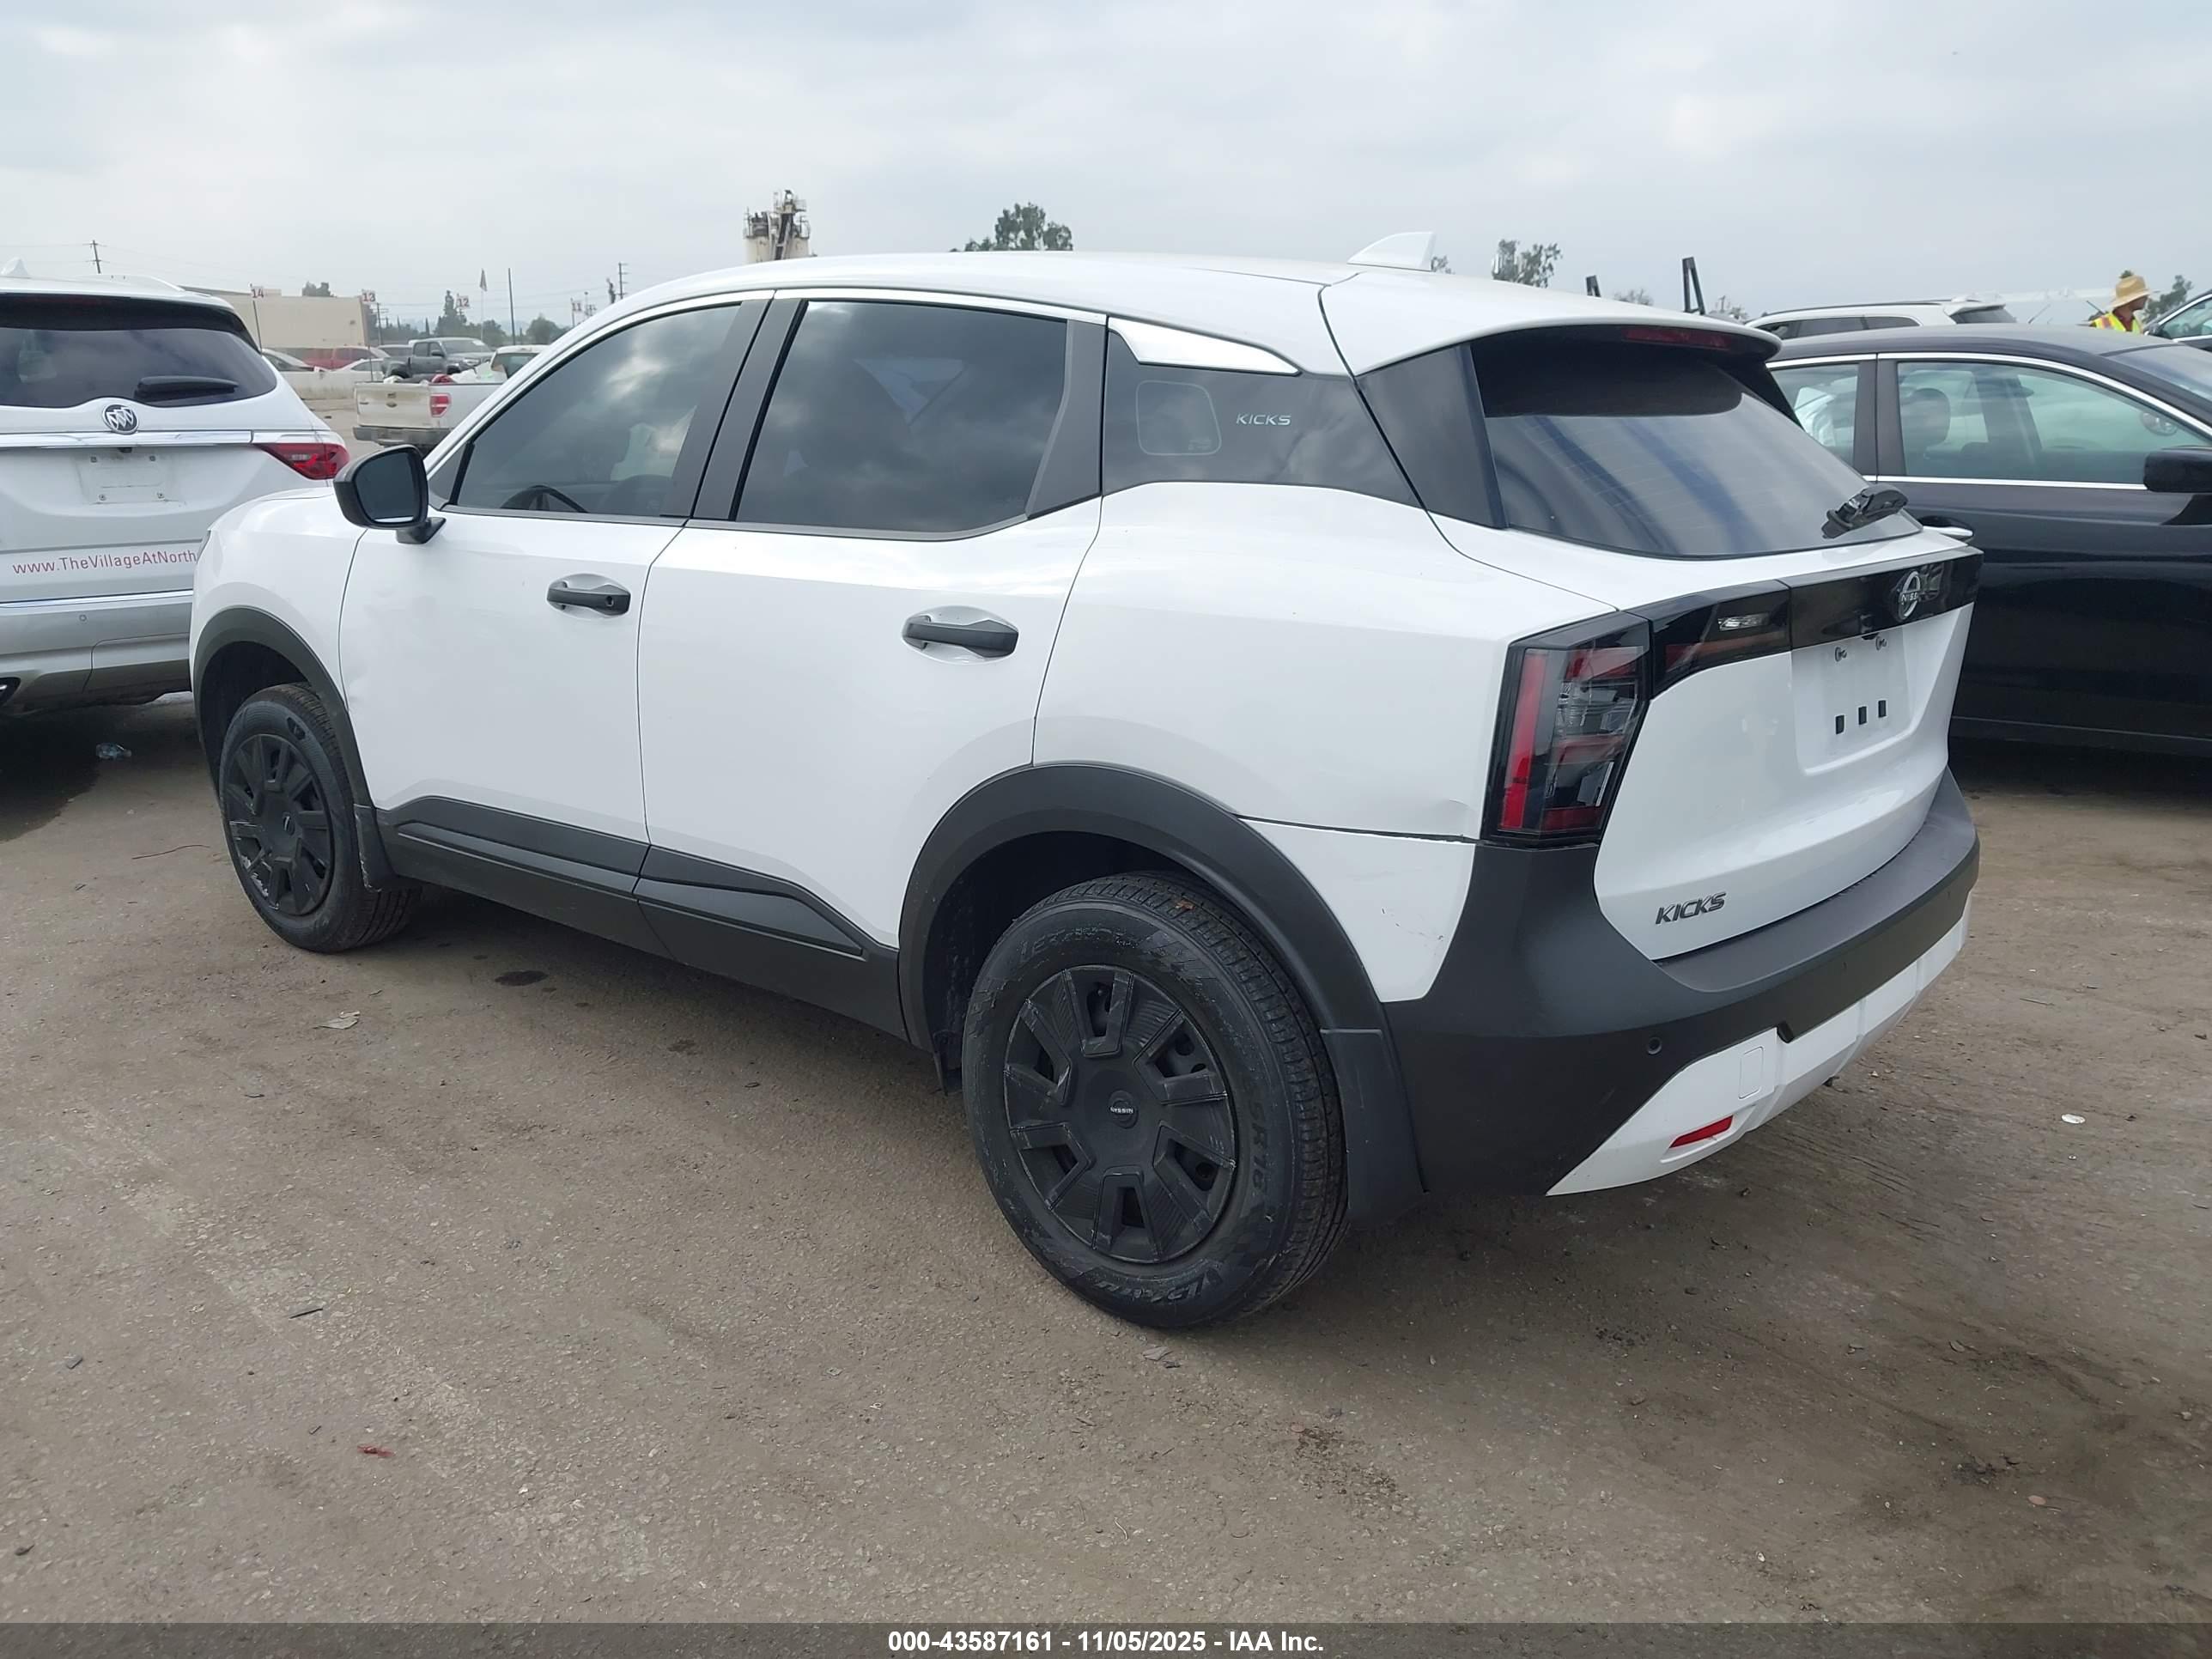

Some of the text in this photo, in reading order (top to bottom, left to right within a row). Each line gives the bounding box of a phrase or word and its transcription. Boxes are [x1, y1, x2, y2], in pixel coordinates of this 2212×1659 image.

[252, 289, 264, 299] 14
[362, 292, 376, 302] 13
[458, 298, 470, 307] 12
[571, 302, 582, 312] 11
[1237, 414, 1291, 426] KICKS
[1656, 892, 1726, 925] KICKS
